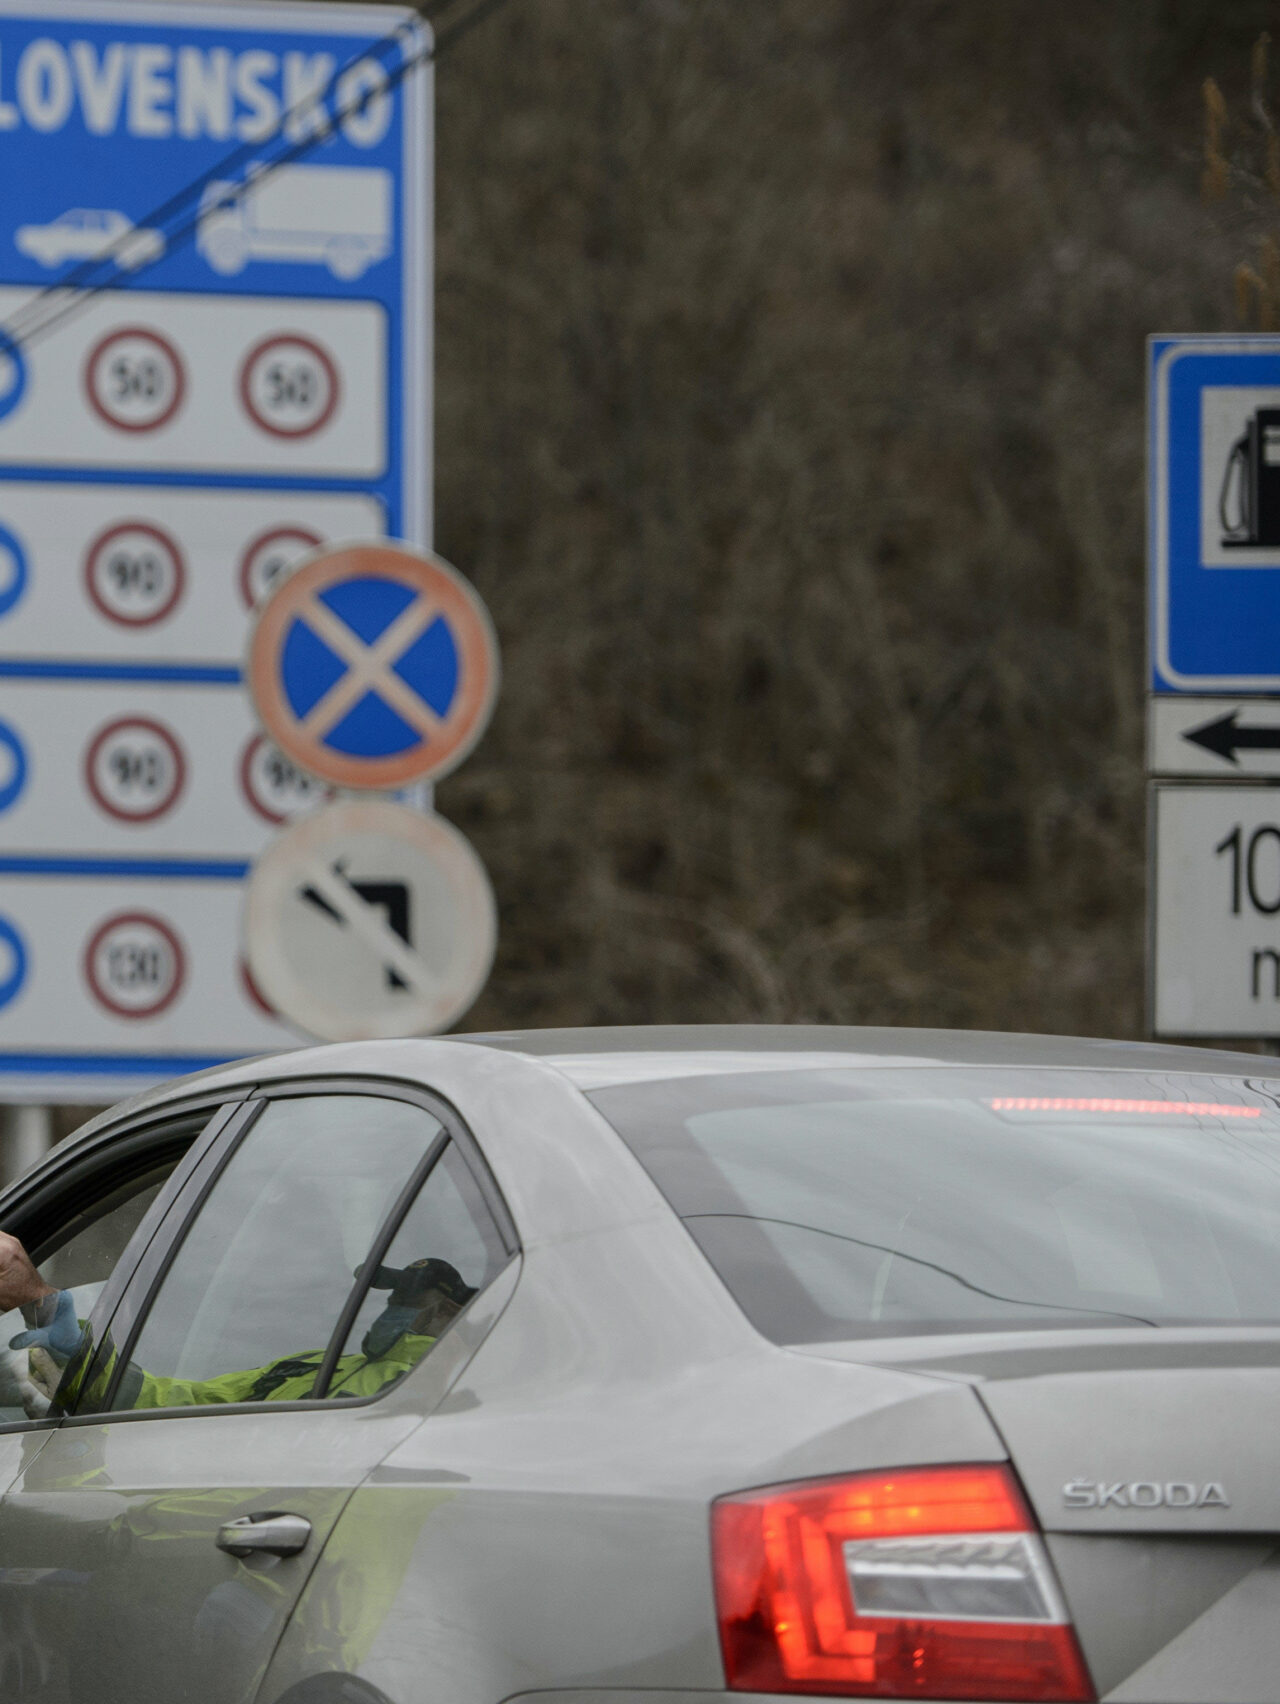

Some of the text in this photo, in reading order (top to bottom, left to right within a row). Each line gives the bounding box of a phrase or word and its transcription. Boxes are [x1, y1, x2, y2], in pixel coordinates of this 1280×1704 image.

[111, 356, 318, 411] 50 50
[108, 551, 163, 599] 90
[110, 747, 164, 795] 90
[108, 944, 168, 988] 130
[1063, 1477, 1231, 1508] ŠKODA
